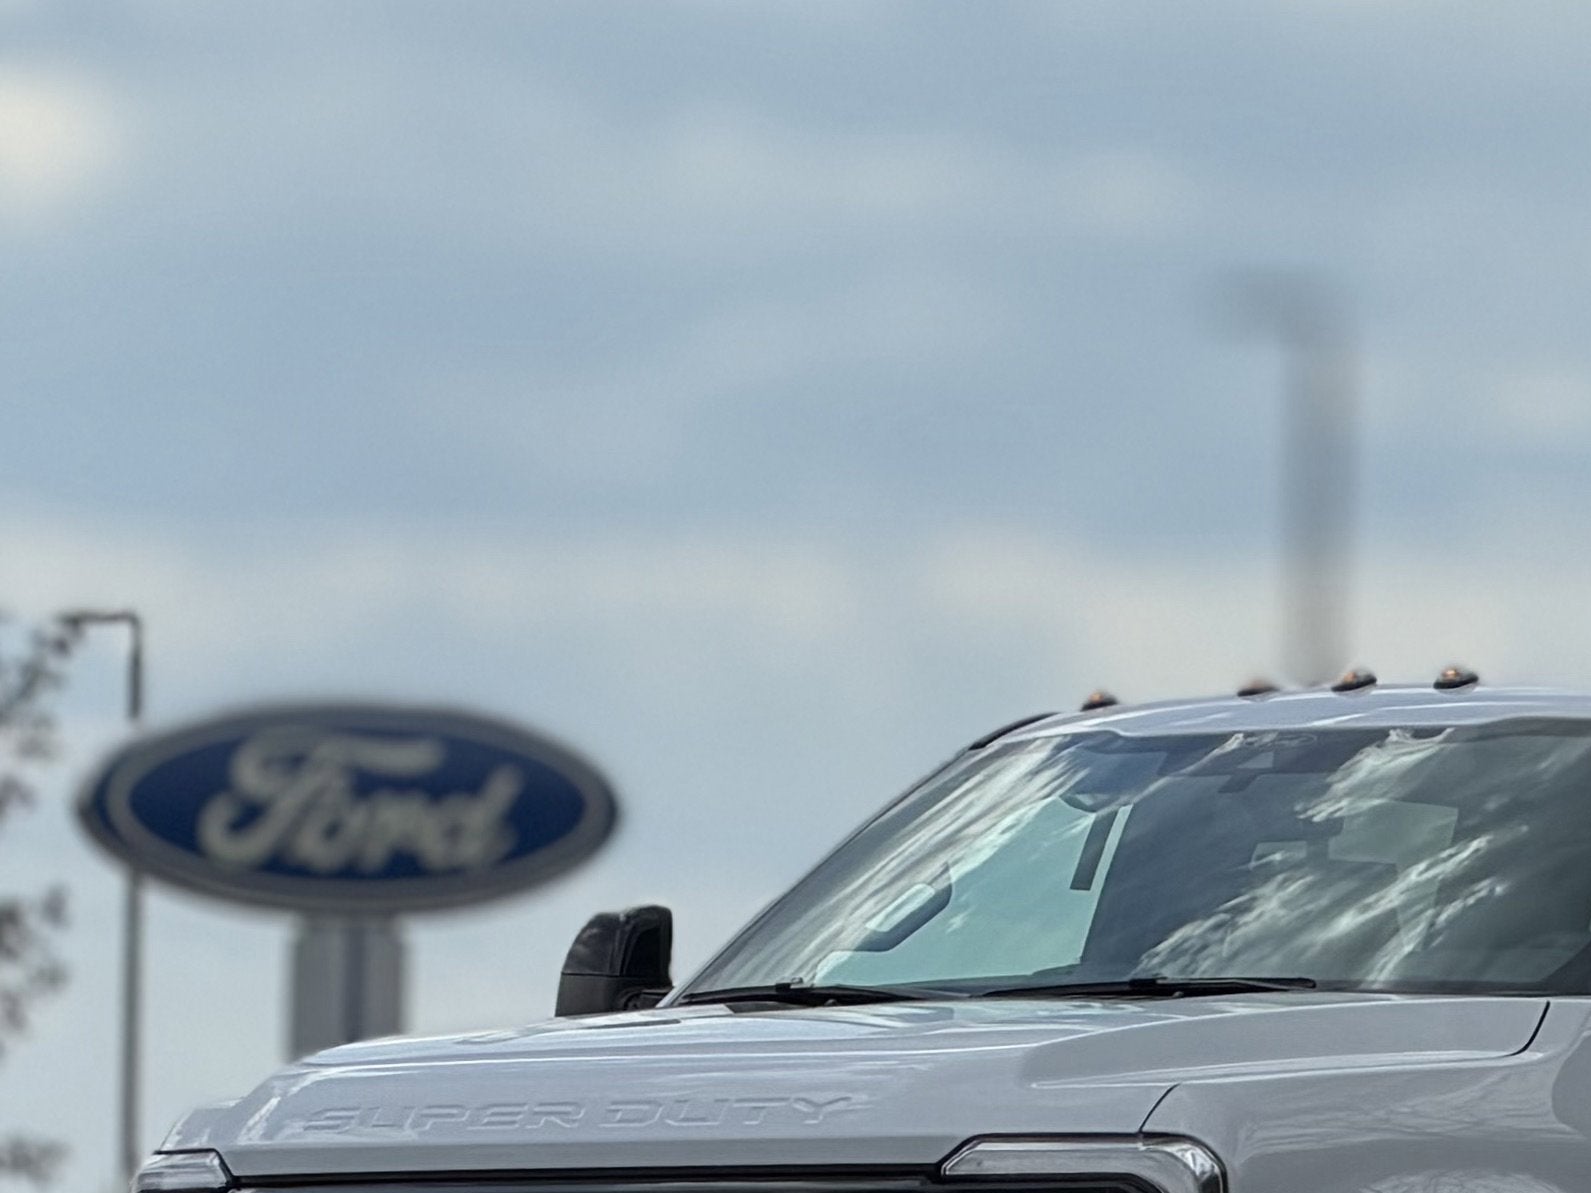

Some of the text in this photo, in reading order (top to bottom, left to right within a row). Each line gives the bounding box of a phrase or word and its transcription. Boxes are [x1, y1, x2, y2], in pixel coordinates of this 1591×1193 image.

[199, 729, 519, 873] Ford
[301, 1097, 862, 1133] SUPER DUTY
